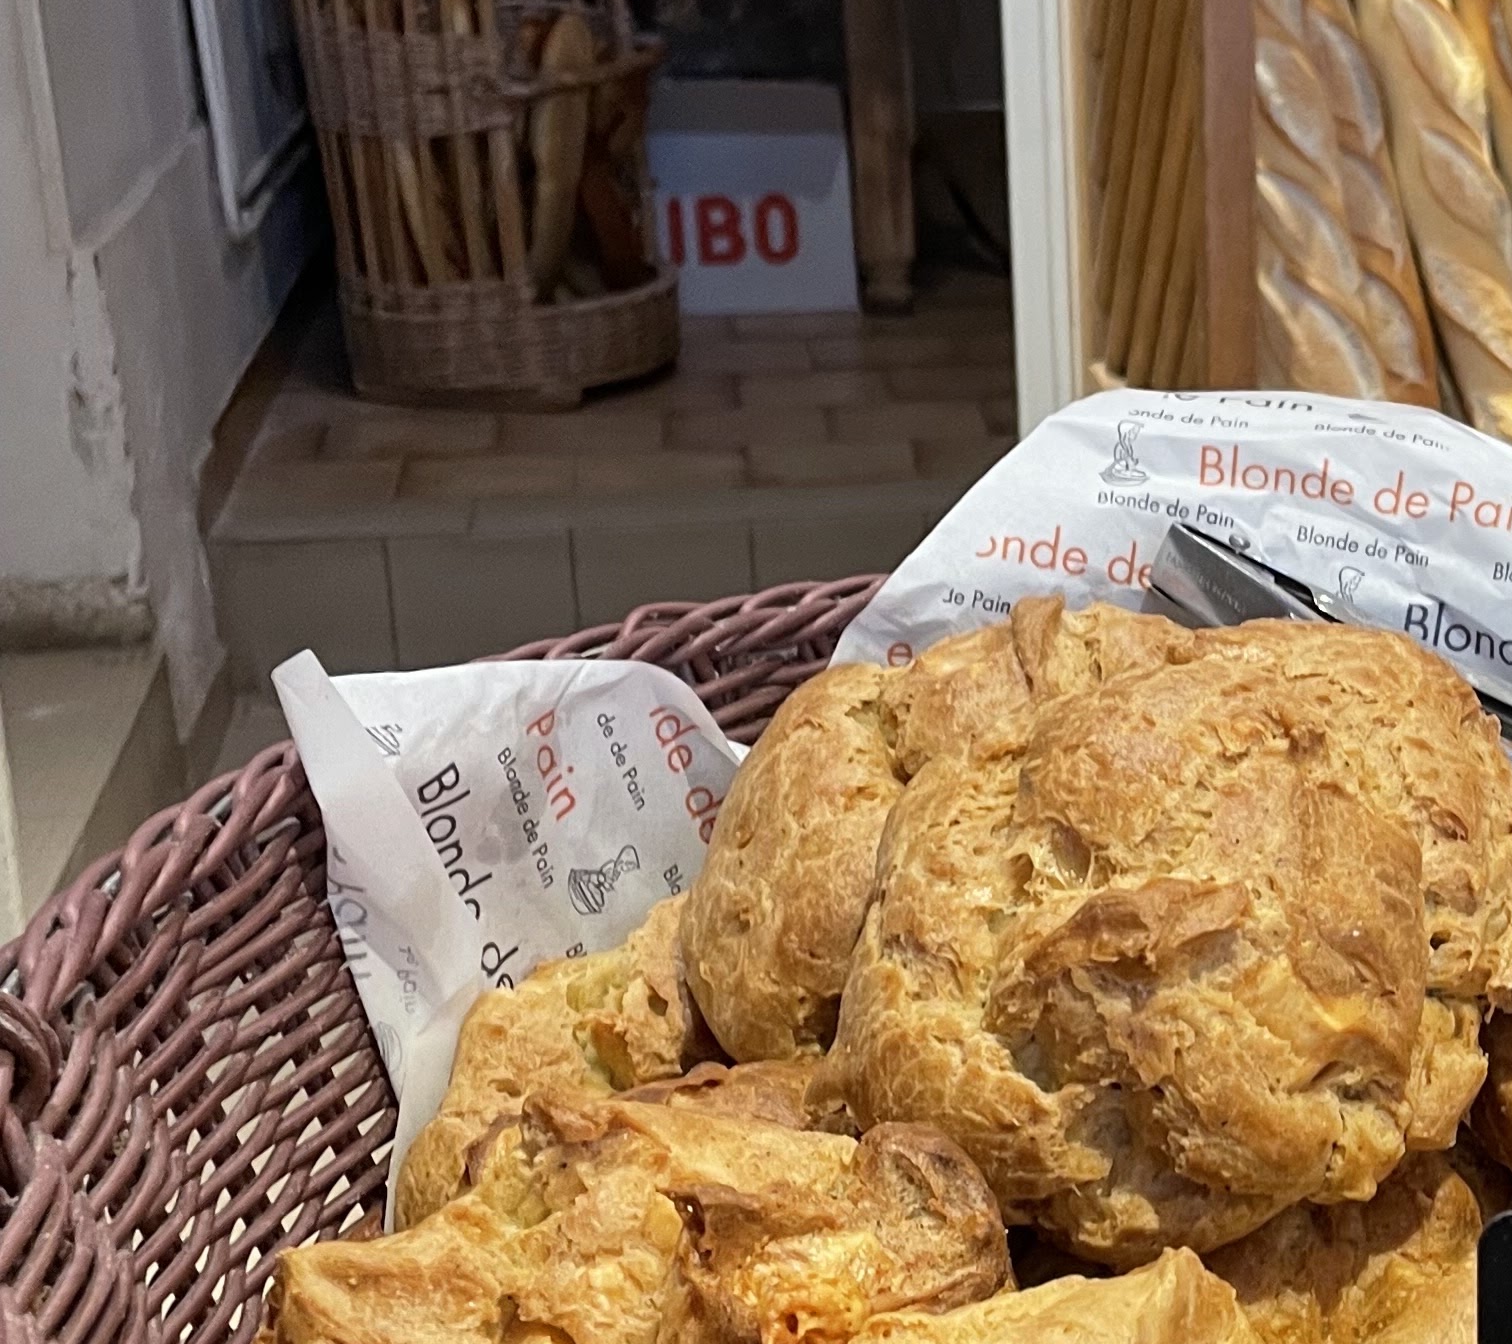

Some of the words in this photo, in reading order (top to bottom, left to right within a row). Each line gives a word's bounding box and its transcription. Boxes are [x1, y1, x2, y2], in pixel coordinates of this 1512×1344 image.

[1181, 410, 1204, 425] de
[1211, 415, 1249, 429] Pain
[1383, 429, 1406, 442] de
[1199, 443, 1355, 506] Blonde
[1373, 470, 1430, 520] de
[1097, 490, 1159, 514] Blonde
[1166, 501, 1190, 520] de
[1196, 503, 1235, 529] Pain
[1296, 525, 1359, 553] Blonde
[1365, 538, 1388, 559] de
[1395, 544, 1429, 568] Pain
[972, 589, 1010, 615] Pain
[526, 709, 576, 821] Pain
[596, 713, 616, 738] de
[610, 741, 628, 768] de
[622, 767, 646, 811] Pain
[497, 747, 530, 816] Blonde
[522, 820, 540, 844] de
[532, 842, 555, 889] Pain
